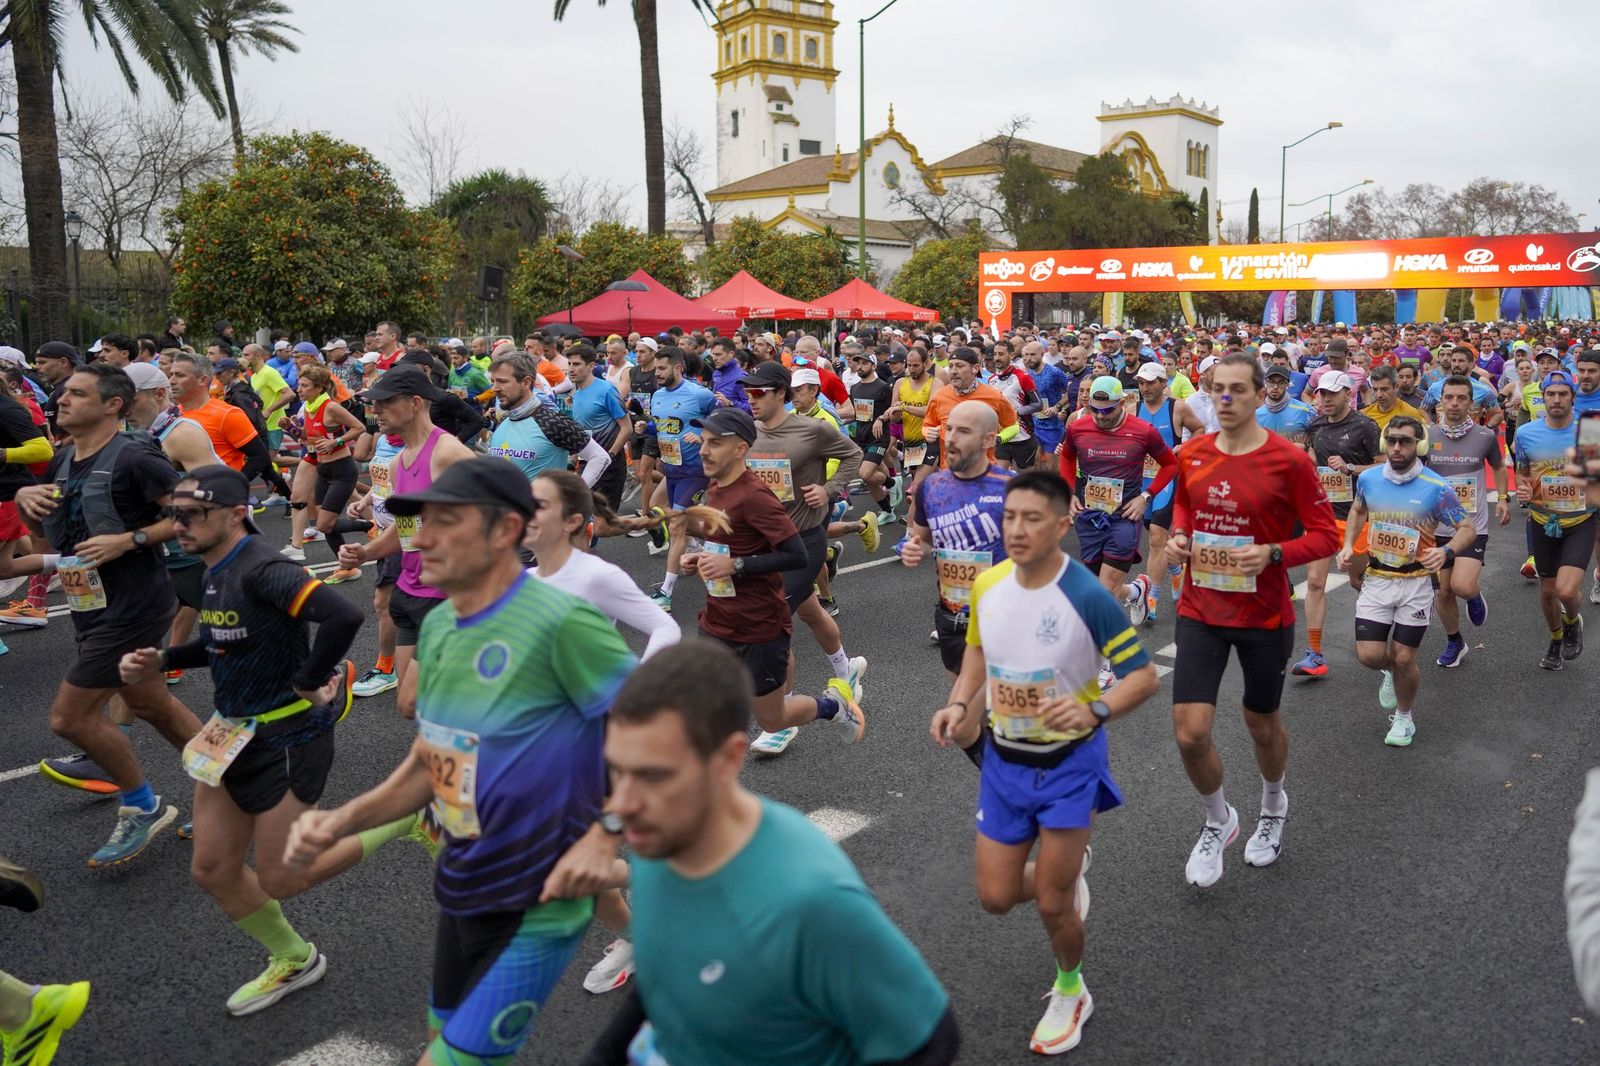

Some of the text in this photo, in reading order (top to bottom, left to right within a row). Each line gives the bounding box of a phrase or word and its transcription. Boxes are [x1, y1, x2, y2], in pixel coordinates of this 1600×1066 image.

[1131, 262, 1174, 277] HOKA
[1393, 253, 1448, 271] HOKA
[1457, 265, 1499, 273] HYUNDAI
[504, 449, 536, 459] POWER
[1089, 485, 1112, 499] 5921
[1548, 486, 1576, 496] 5498
[937, 503, 979, 527] MARATÓN
[1377, 533, 1406, 550] 5903
[943, 563, 976, 581] 5932
[998, 684, 1039, 708] 5365
